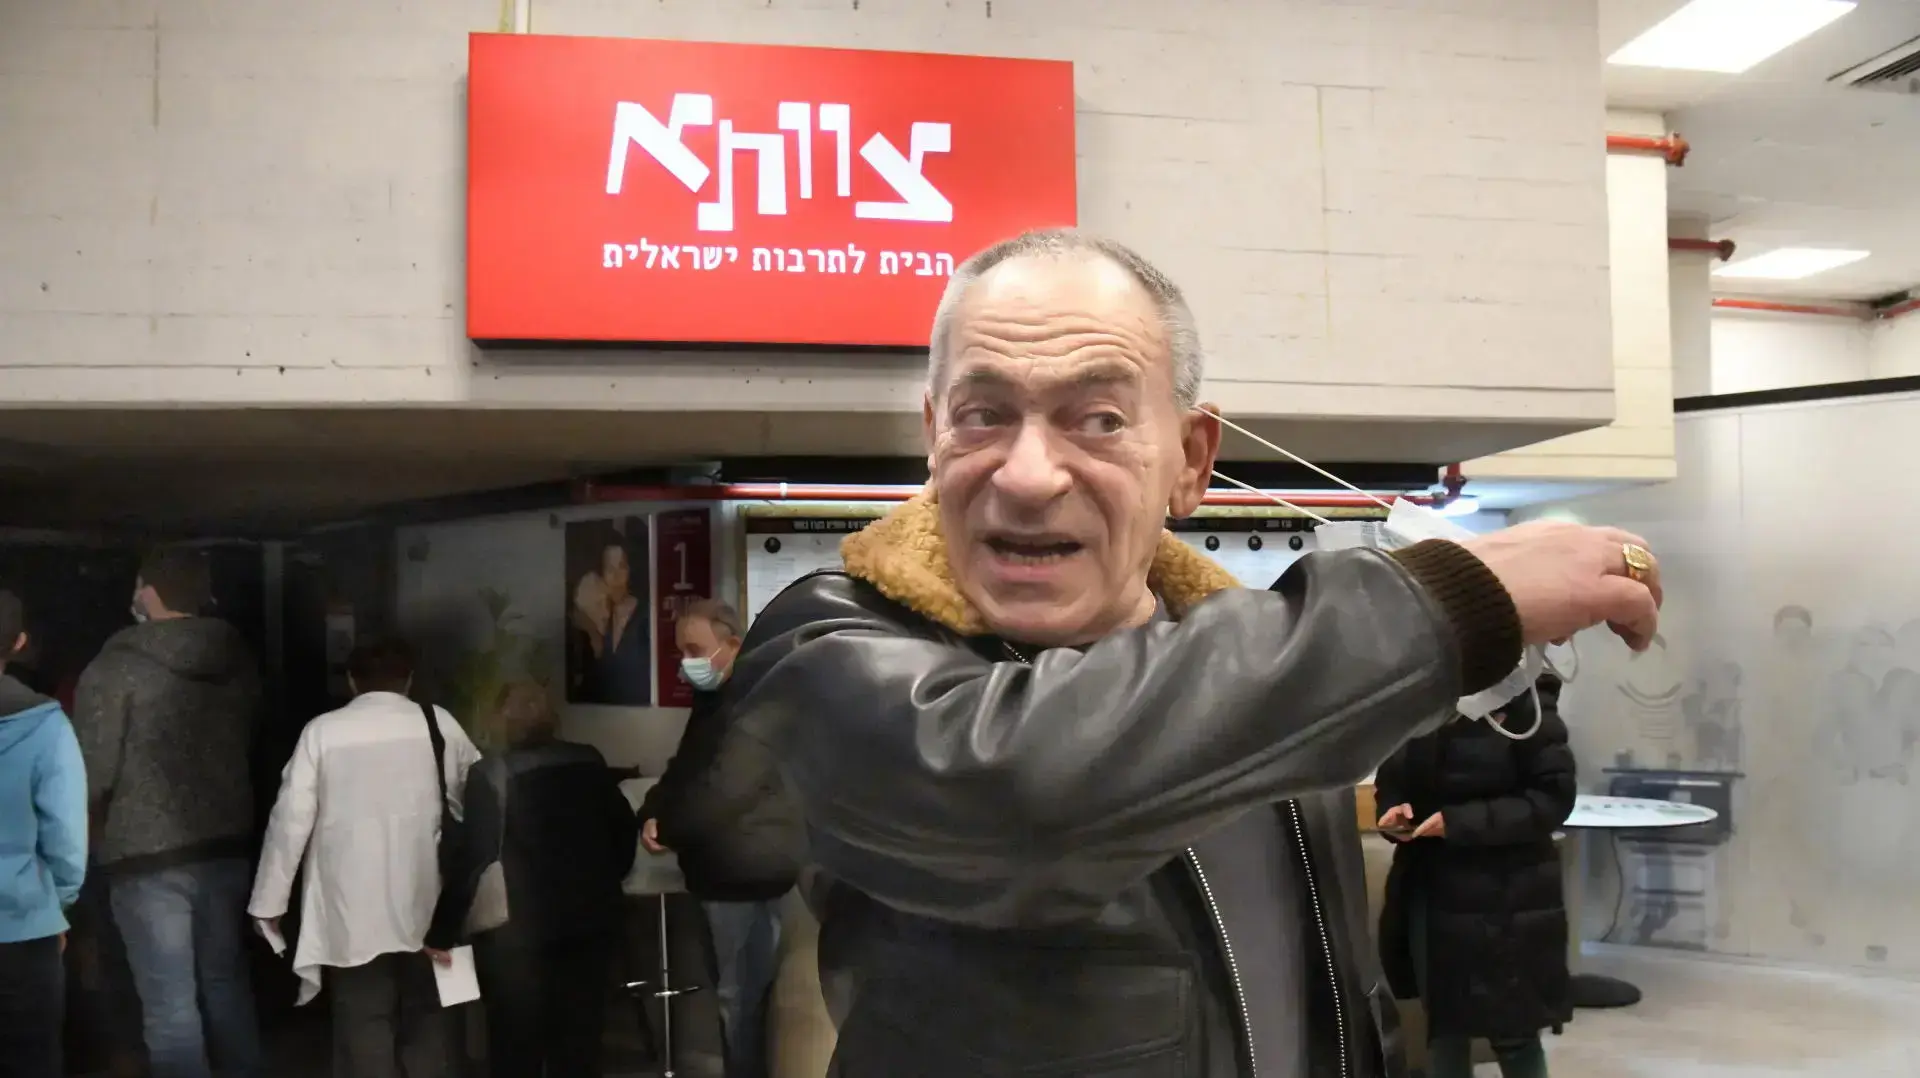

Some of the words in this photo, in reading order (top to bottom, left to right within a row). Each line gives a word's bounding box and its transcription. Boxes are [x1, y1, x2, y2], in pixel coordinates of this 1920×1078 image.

[605, 91, 954, 231] צוותא
[602, 236, 738, 270] ישראלית
[751, 242, 866, 274] לתרבות
[879, 250, 954, 276] הבית
